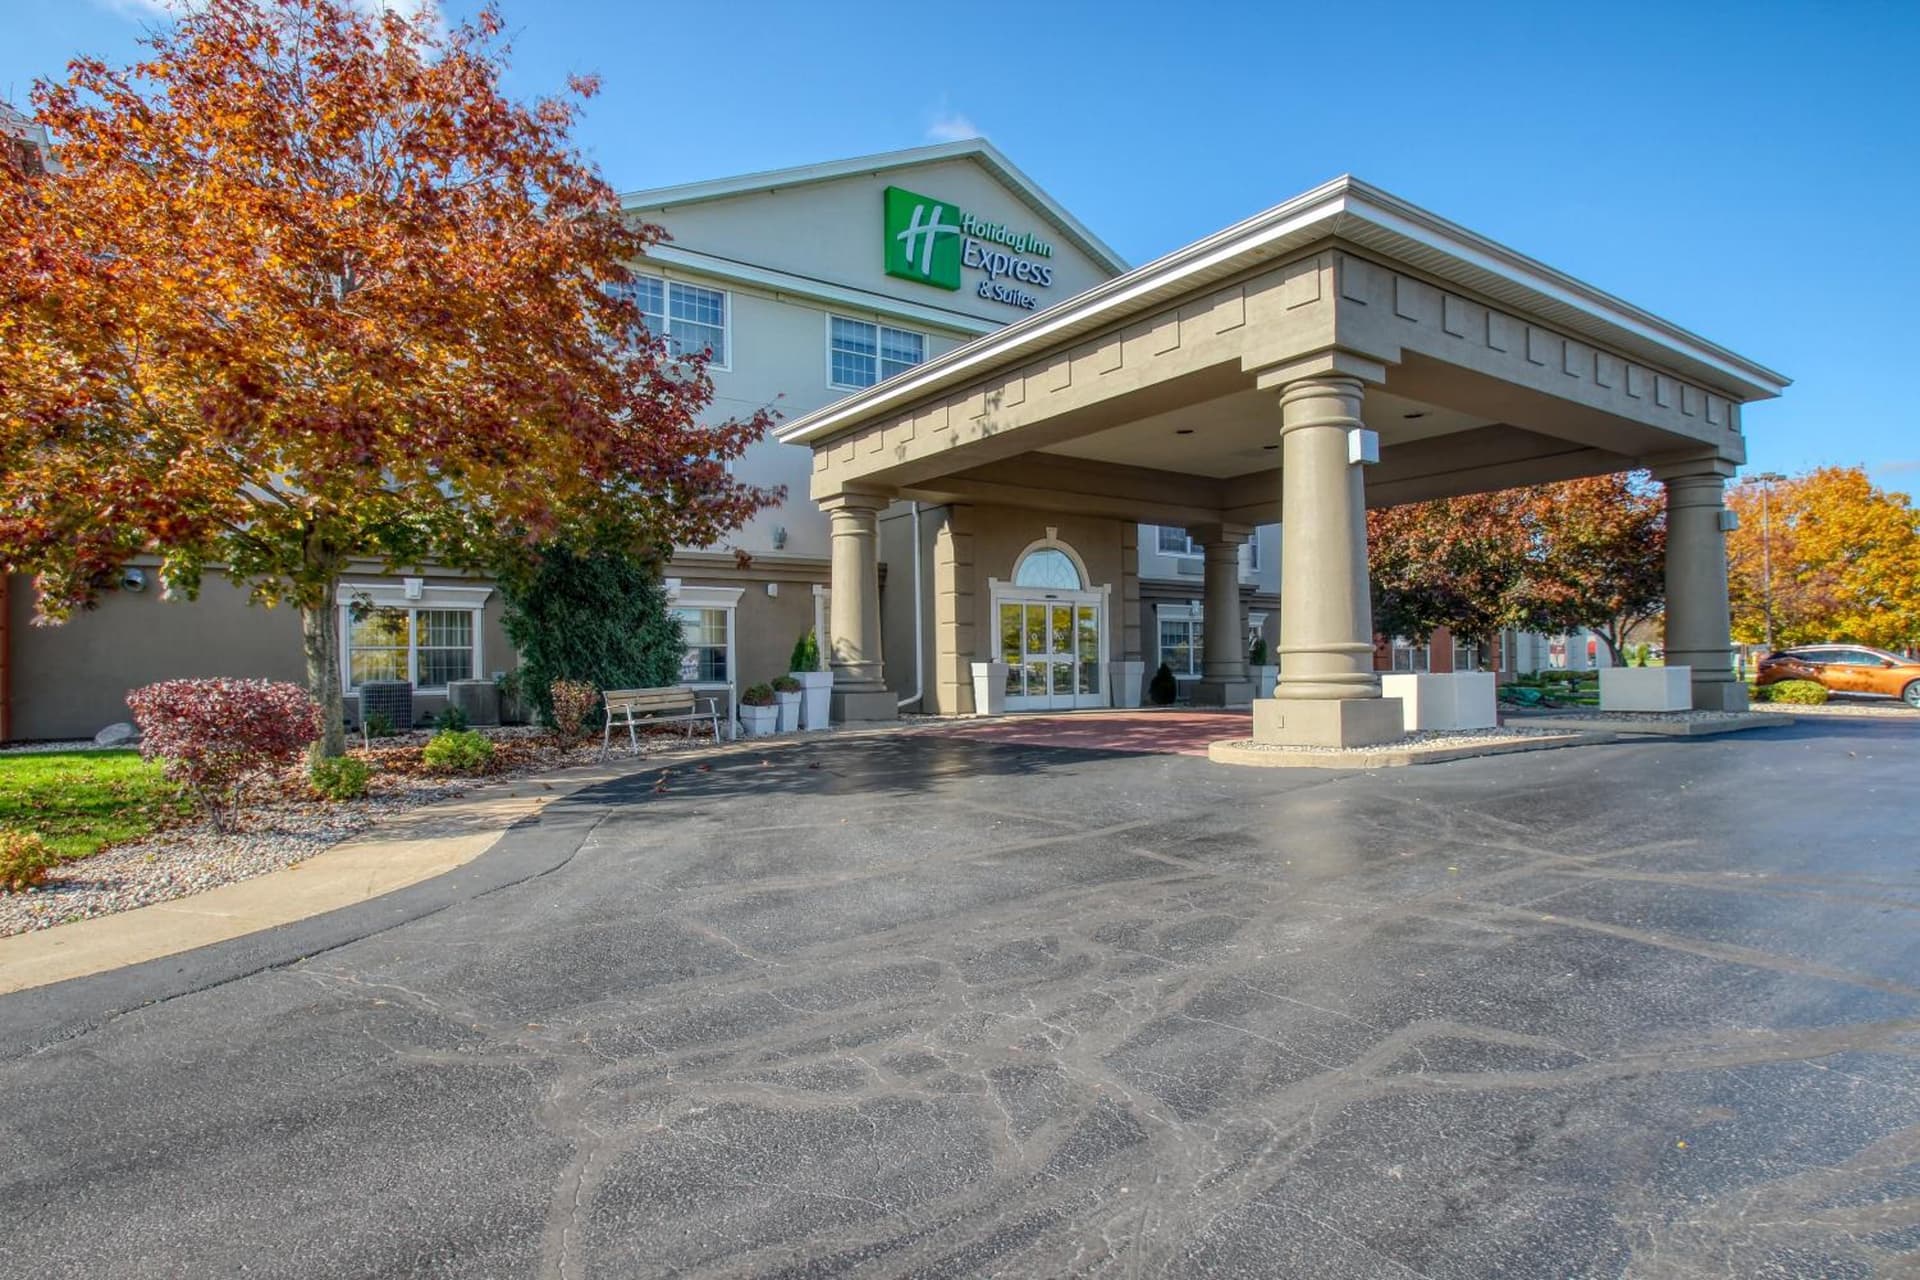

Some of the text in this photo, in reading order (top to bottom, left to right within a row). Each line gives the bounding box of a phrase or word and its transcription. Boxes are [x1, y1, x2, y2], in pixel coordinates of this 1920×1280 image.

[962, 213, 1053, 258] Holiday Inn
[962, 237, 1052, 287] Express
[978, 280, 1037, 310] & Suites
